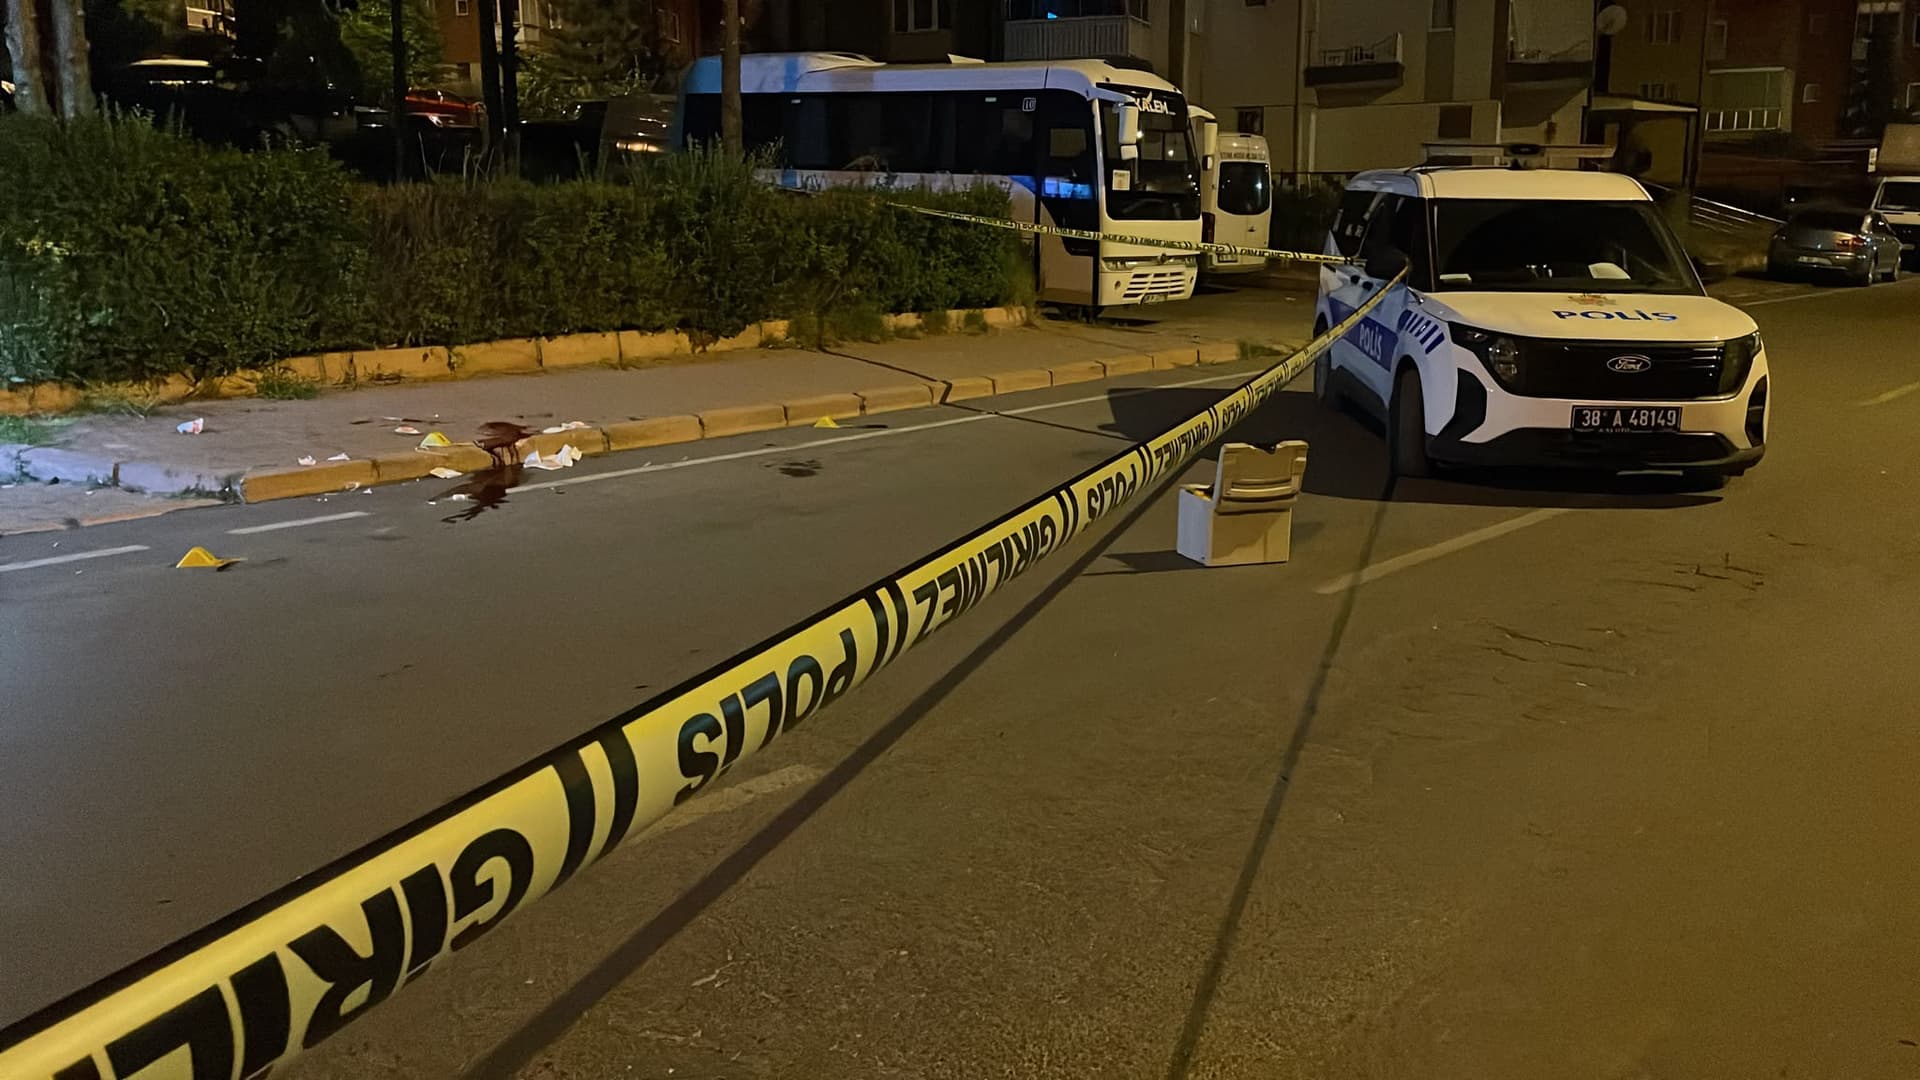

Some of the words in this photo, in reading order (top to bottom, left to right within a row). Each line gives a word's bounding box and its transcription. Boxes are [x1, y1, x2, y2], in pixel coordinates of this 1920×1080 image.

[1615, 358, 1642, 370] Ford
[1582, 410, 1600, 426] 38
[1613, 410, 1622, 426] A
[1629, 410, 1676, 427] 48149
